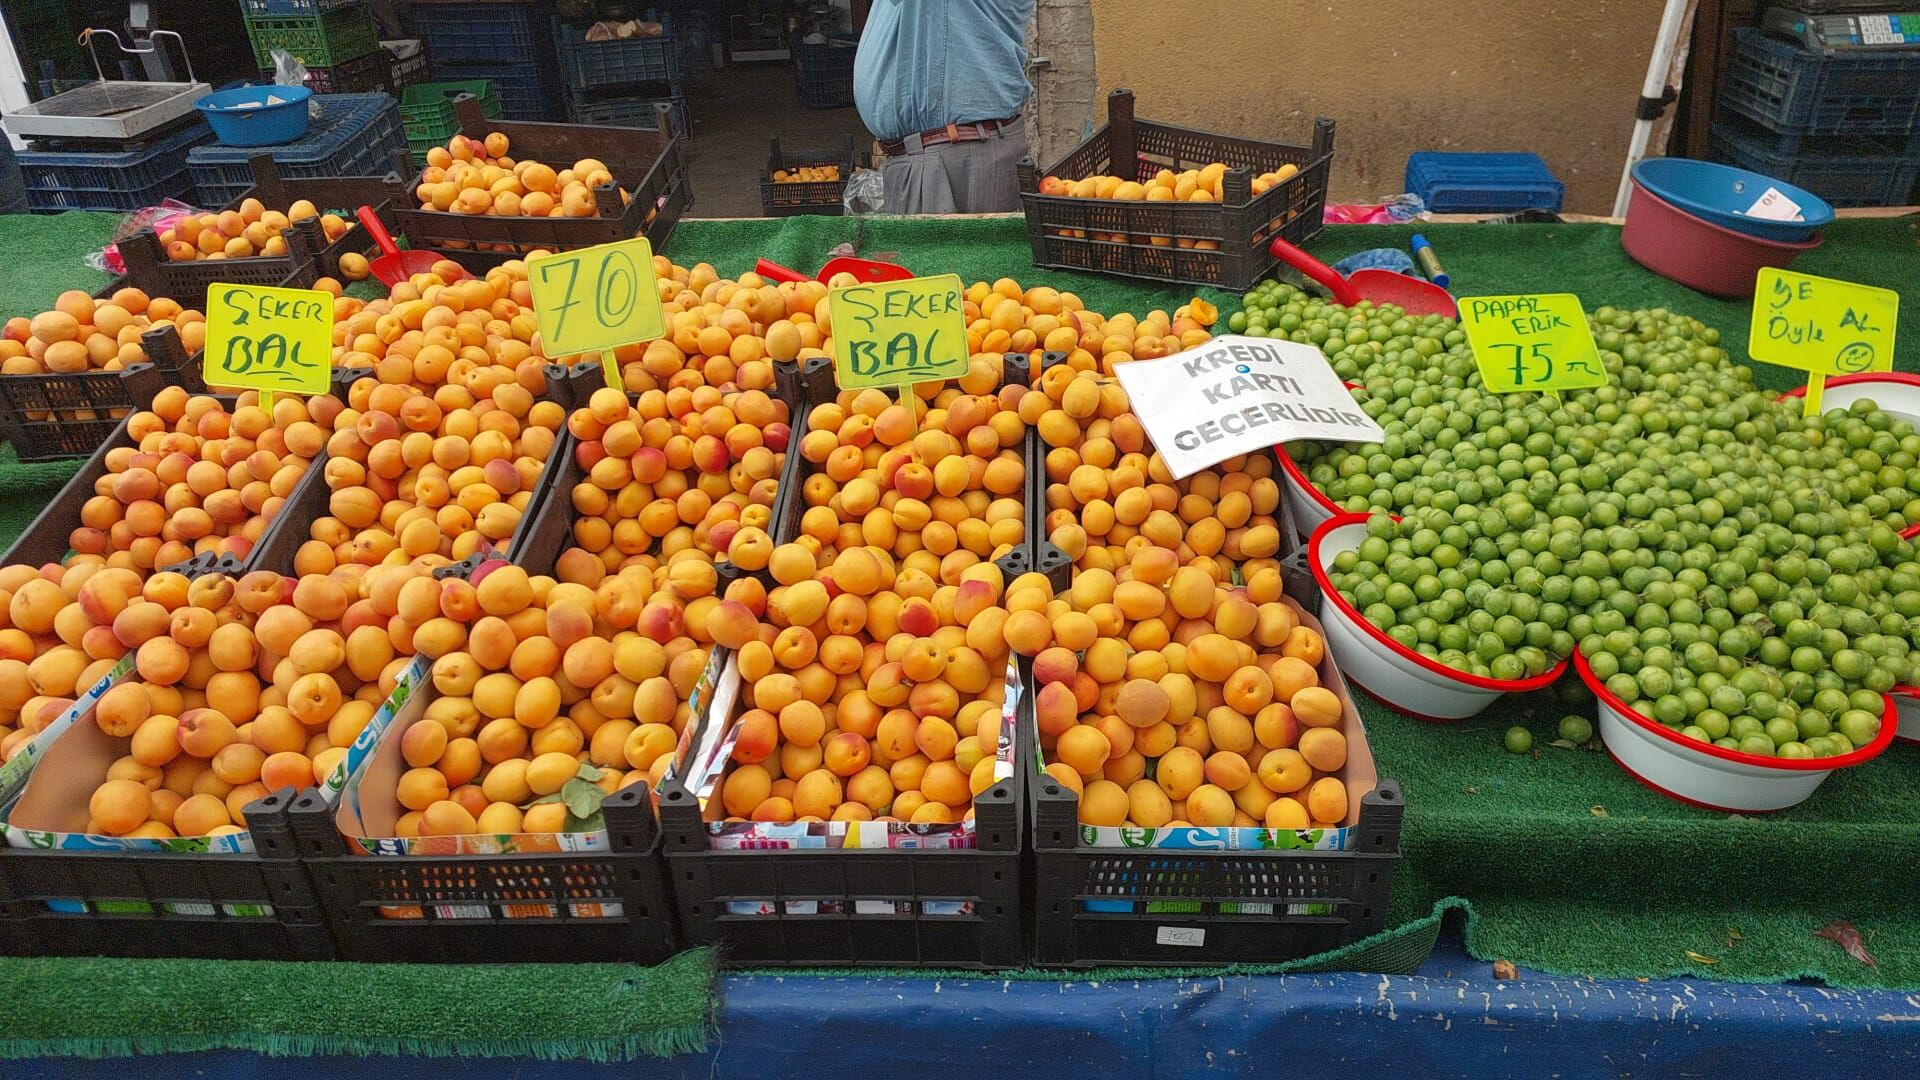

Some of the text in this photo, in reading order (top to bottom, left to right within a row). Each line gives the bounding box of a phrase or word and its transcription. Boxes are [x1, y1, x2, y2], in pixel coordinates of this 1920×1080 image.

[541, 251, 637, 342] 70
[1472, 297, 1550, 323] PAPAZ
[1840, 308, 1880, 332] AL
[223, 334, 319, 373] BAL
[849, 329, 957, 375] BAL
[1183, 344, 1285, 378] KREDİ
[1488, 344, 1553, 384] 75
[1202, 372, 1304, 405] KARTI
[1174, 402, 1371, 451] GEÇERLİDİR
